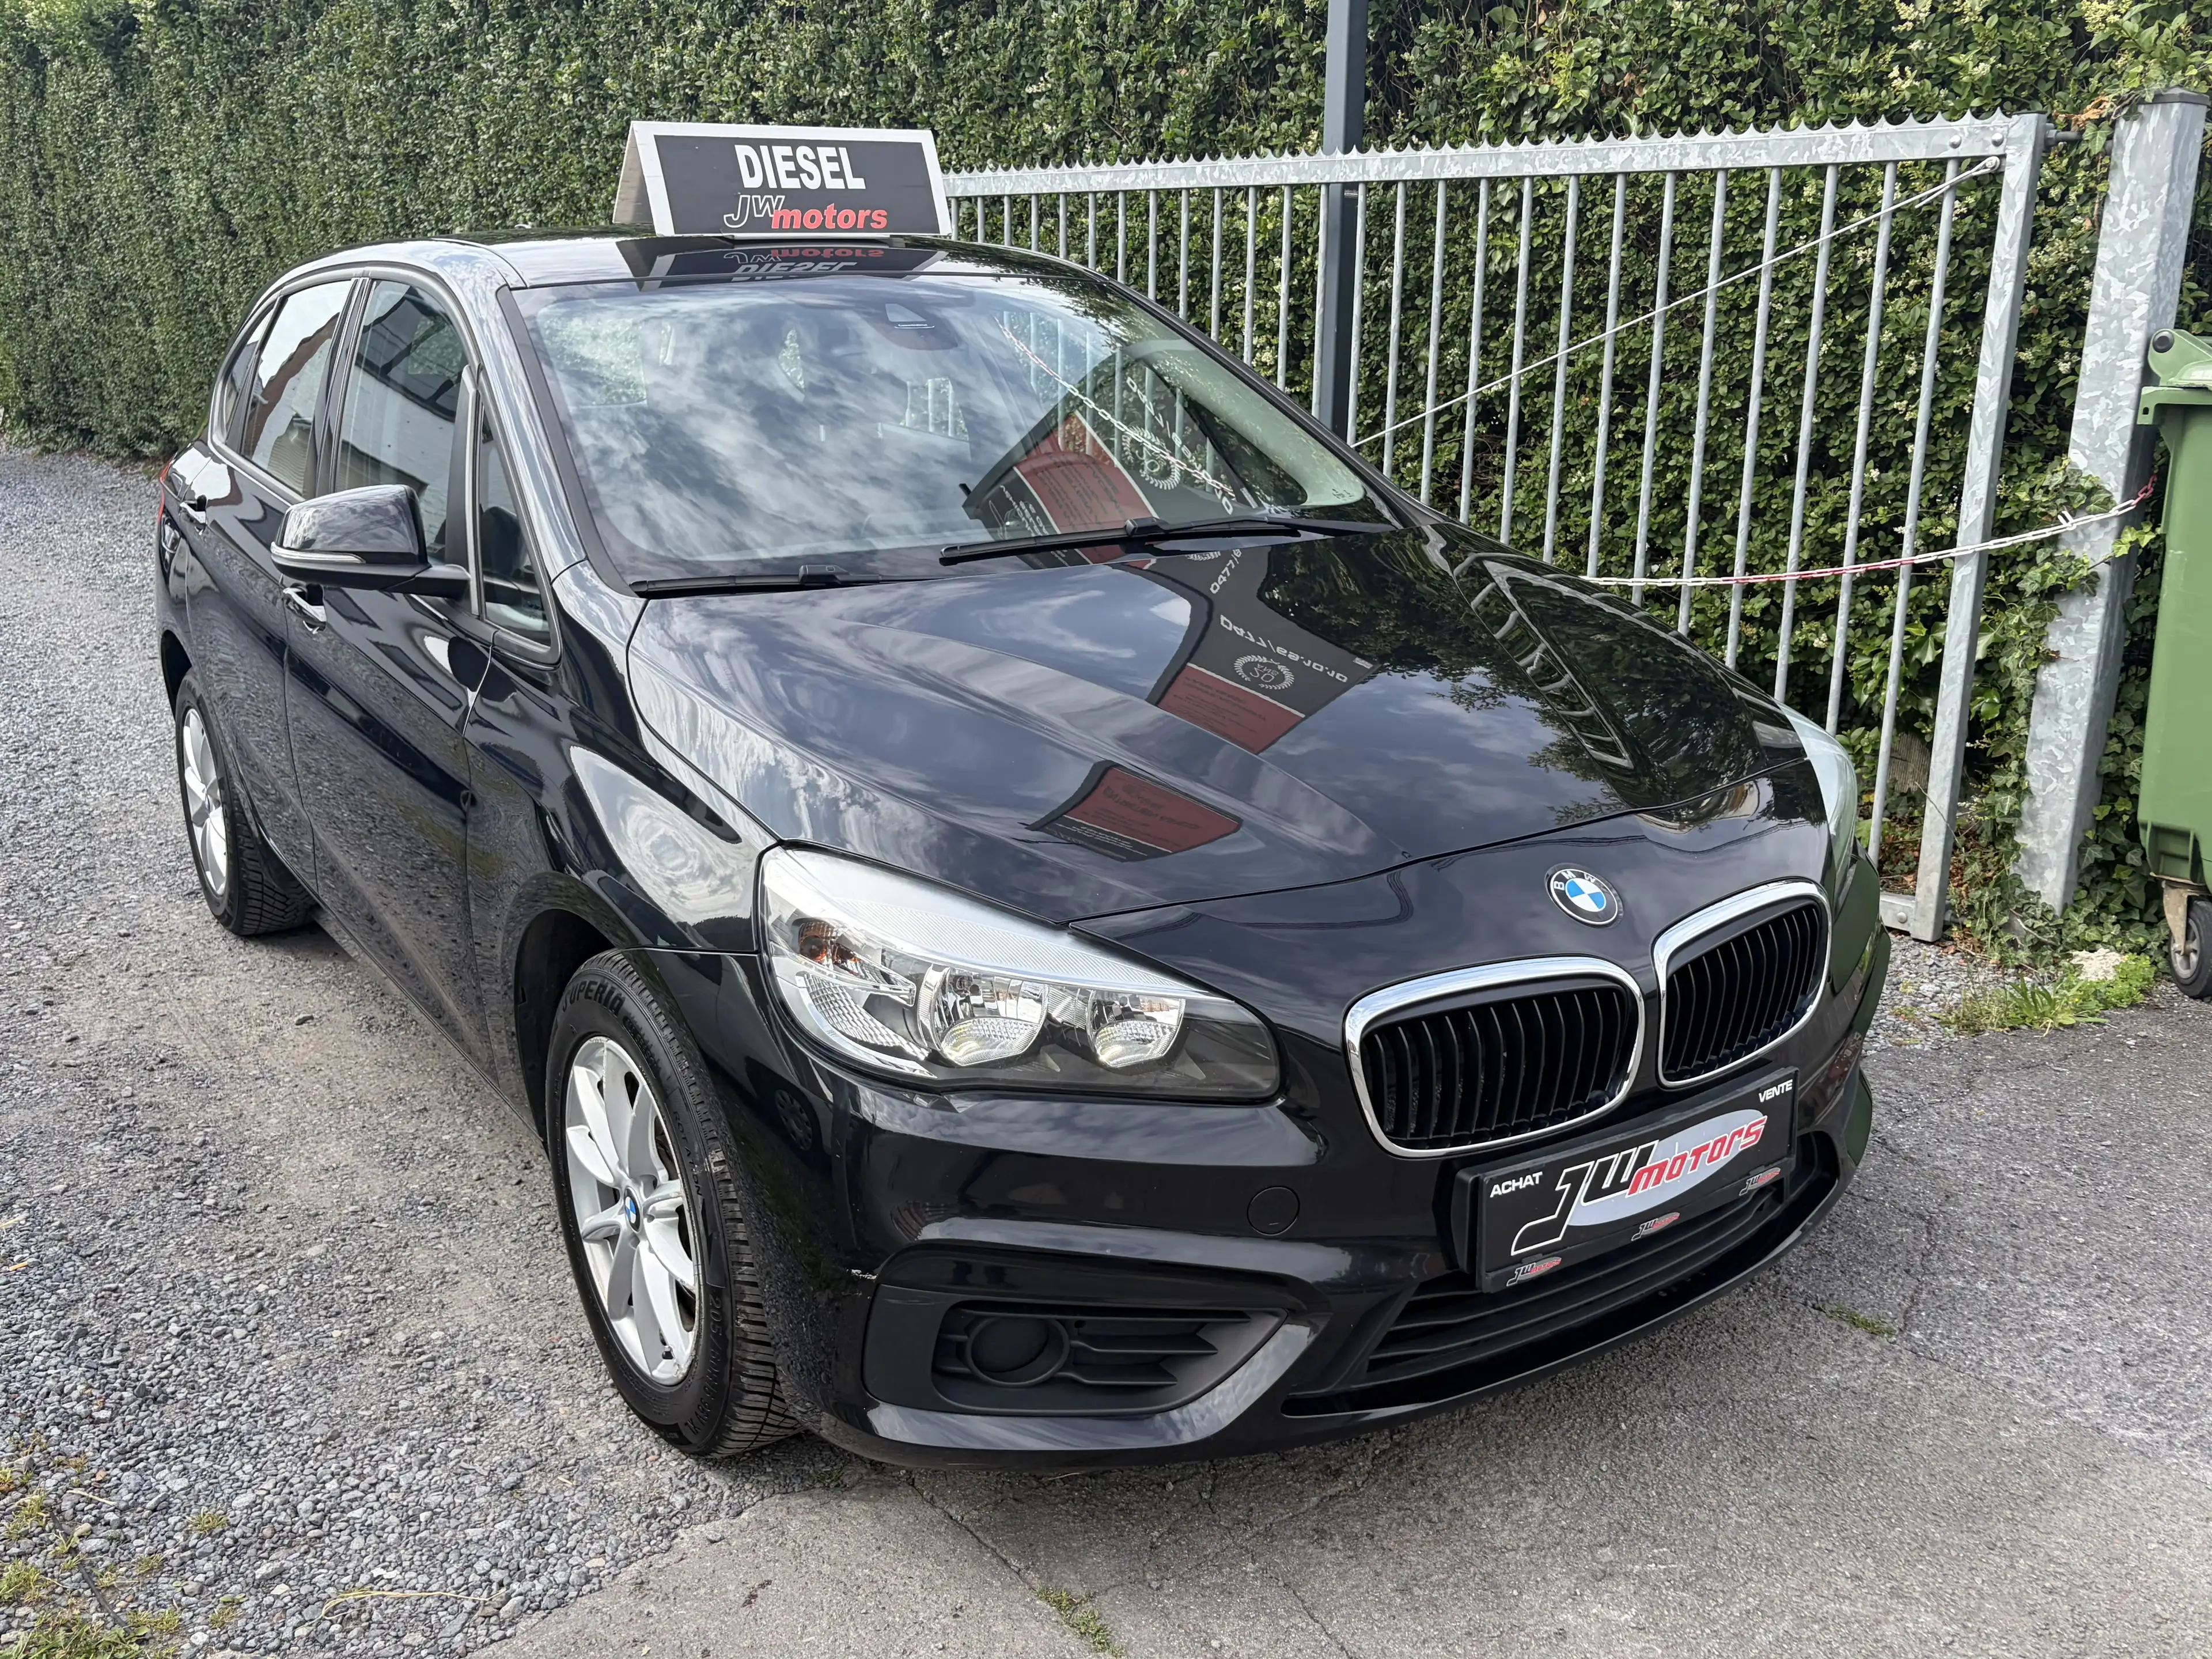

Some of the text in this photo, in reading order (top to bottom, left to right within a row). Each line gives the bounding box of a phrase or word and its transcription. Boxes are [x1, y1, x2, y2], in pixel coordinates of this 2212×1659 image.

[734, 144, 866, 190] DIESEL
[1553, 870, 1596, 891] BMW
[562, 980, 626, 1018] SUPERIA
[1758, 1079, 1793, 1103] VENTE
[1490, 1171, 1543, 1198] ACHAT
